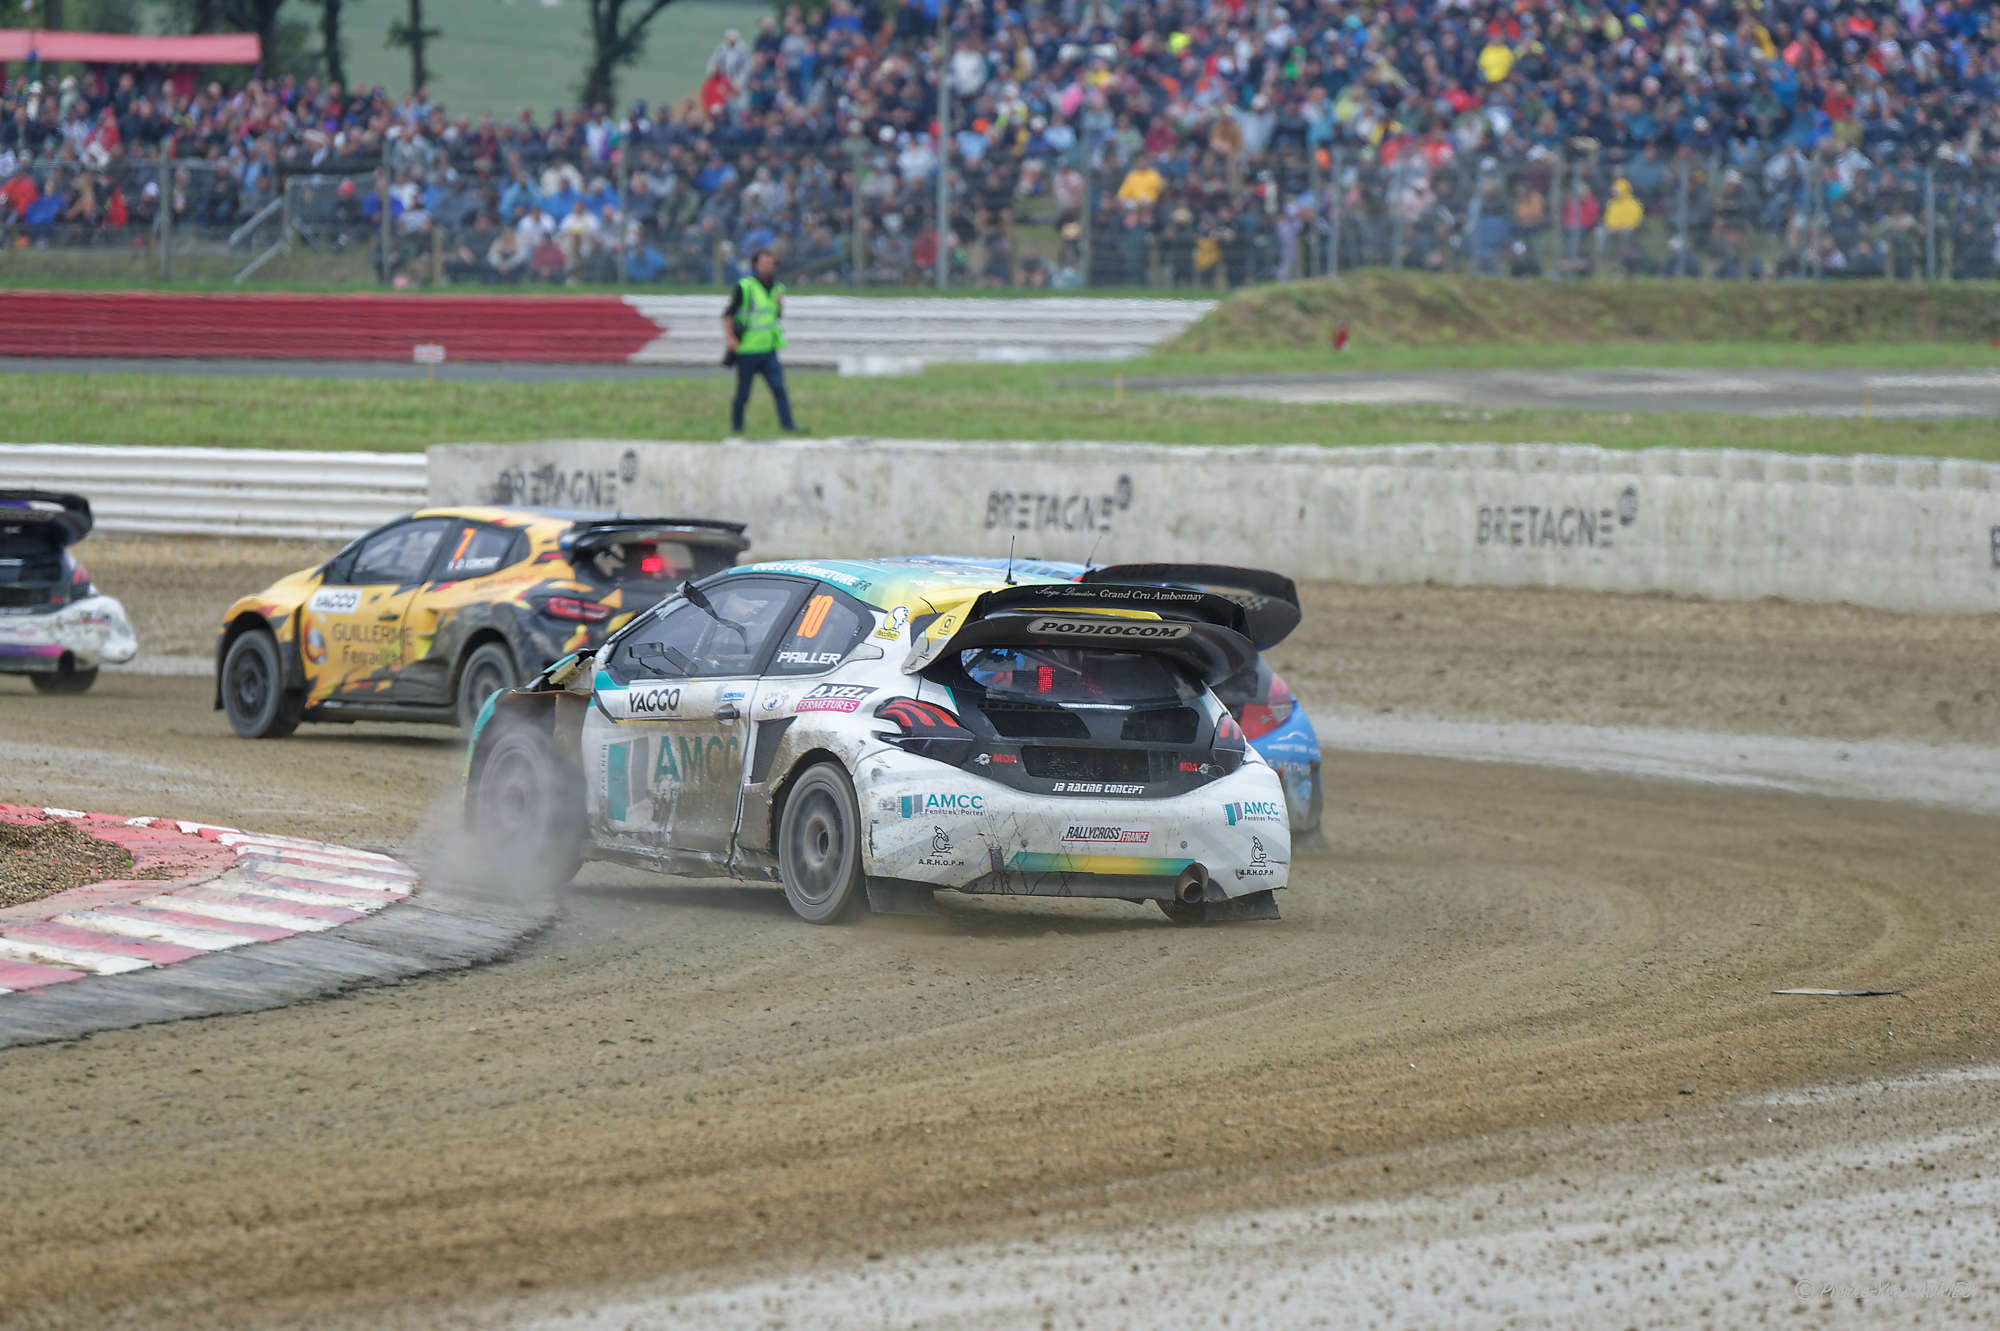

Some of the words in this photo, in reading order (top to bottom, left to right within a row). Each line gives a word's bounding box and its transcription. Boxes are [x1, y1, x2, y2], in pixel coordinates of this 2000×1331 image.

[985, 491, 1112, 532] BRETAGNE
[1478, 504, 1613, 548] BRETAGNE
[453, 527, 477, 561] 1
[1099, 589, 1130, 600] Grand
[1132, 590, 1151, 600] Cru
[1152, 592, 1204, 602] Ambonnay
[796, 594, 834, 639] 10
[1039, 622, 1181, 637] PODIOCOM
[776, 651, 842, 666] PAILLER
[629, 688, 680, 712] YACCO
[799, 700, 857, 712] FERMETURES
[654, 736, 740, 784] AMCC
[1052, 782, 1063, 792] JB
[1066, 783, 1102, 793] RACING
[1104, 784, 1145, 794] CONCEPT
[926, 794, 984, 809] AMCC
[1244, 801, 1279, 816] AMCC
[1066, 826, 1121, 840] RALLYCROSS
[1122, 833, 1148, 843] FRANCE
